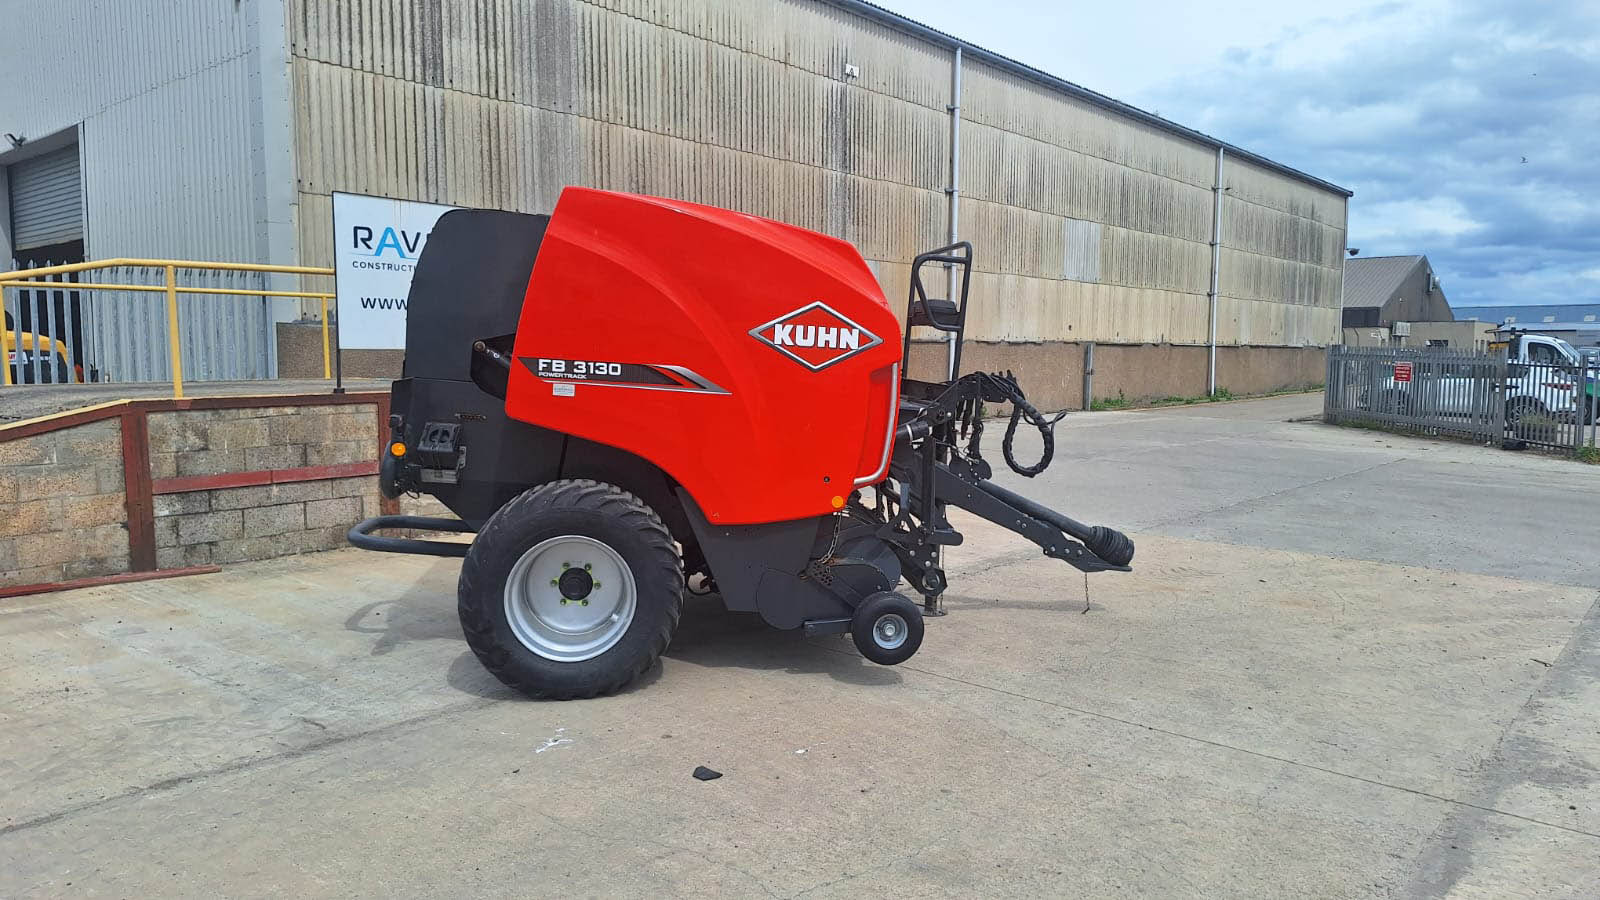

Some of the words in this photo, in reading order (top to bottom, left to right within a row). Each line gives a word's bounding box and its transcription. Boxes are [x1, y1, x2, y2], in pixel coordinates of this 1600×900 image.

[353, 226, 430, 257] RAV
[773, 323, 860, 350] KUHN
[538, 359, 566, 372] FB
[573, 361, 622, 376] 3130
[538, 371, 588, 380] POWERTRACK
